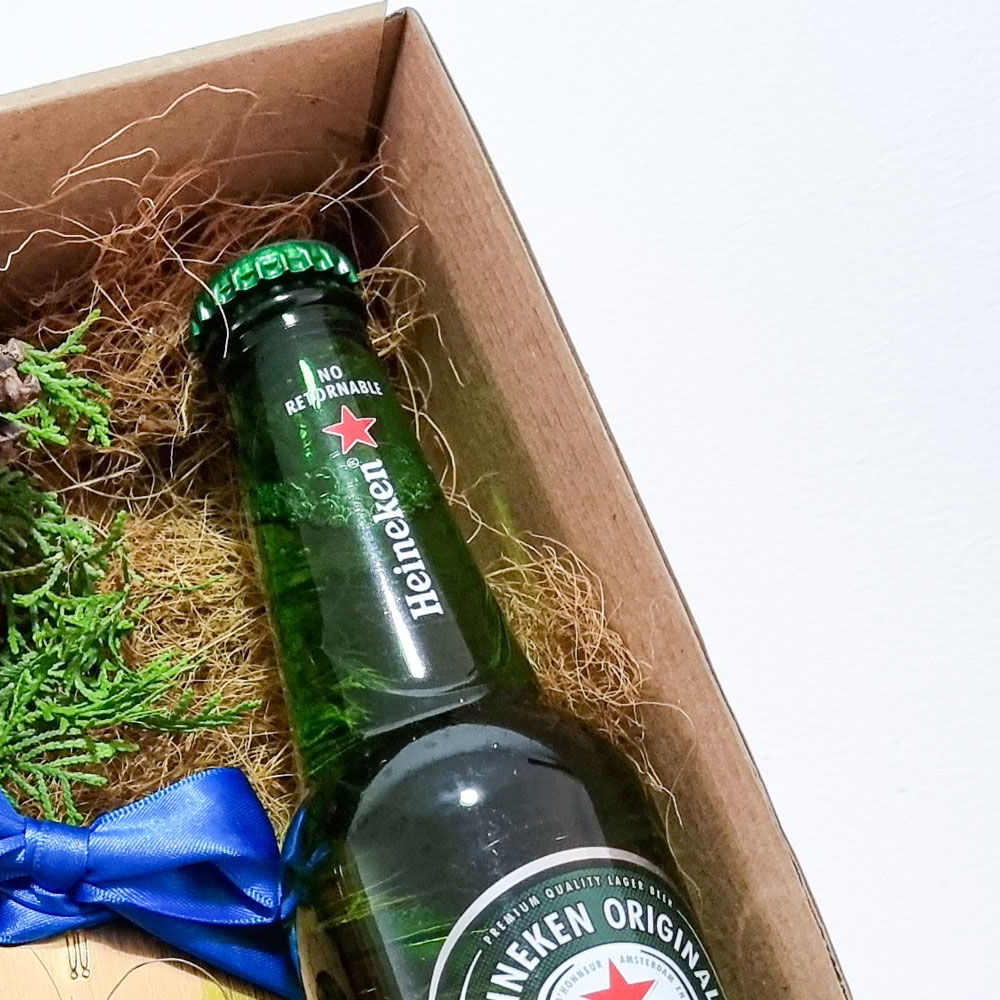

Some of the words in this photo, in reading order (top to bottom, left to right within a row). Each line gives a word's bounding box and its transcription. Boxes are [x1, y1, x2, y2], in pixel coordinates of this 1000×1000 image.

[317, 364, 343, 383] NO
[360, 458, 444, 620] Heineken
[483, 895, 540, 945] PREMIUM
[545, 875, 601, 899] QUALITY
[608, 875, 645, 890] LAGER
[619, 955, 675, 983] AMSTERDAM
